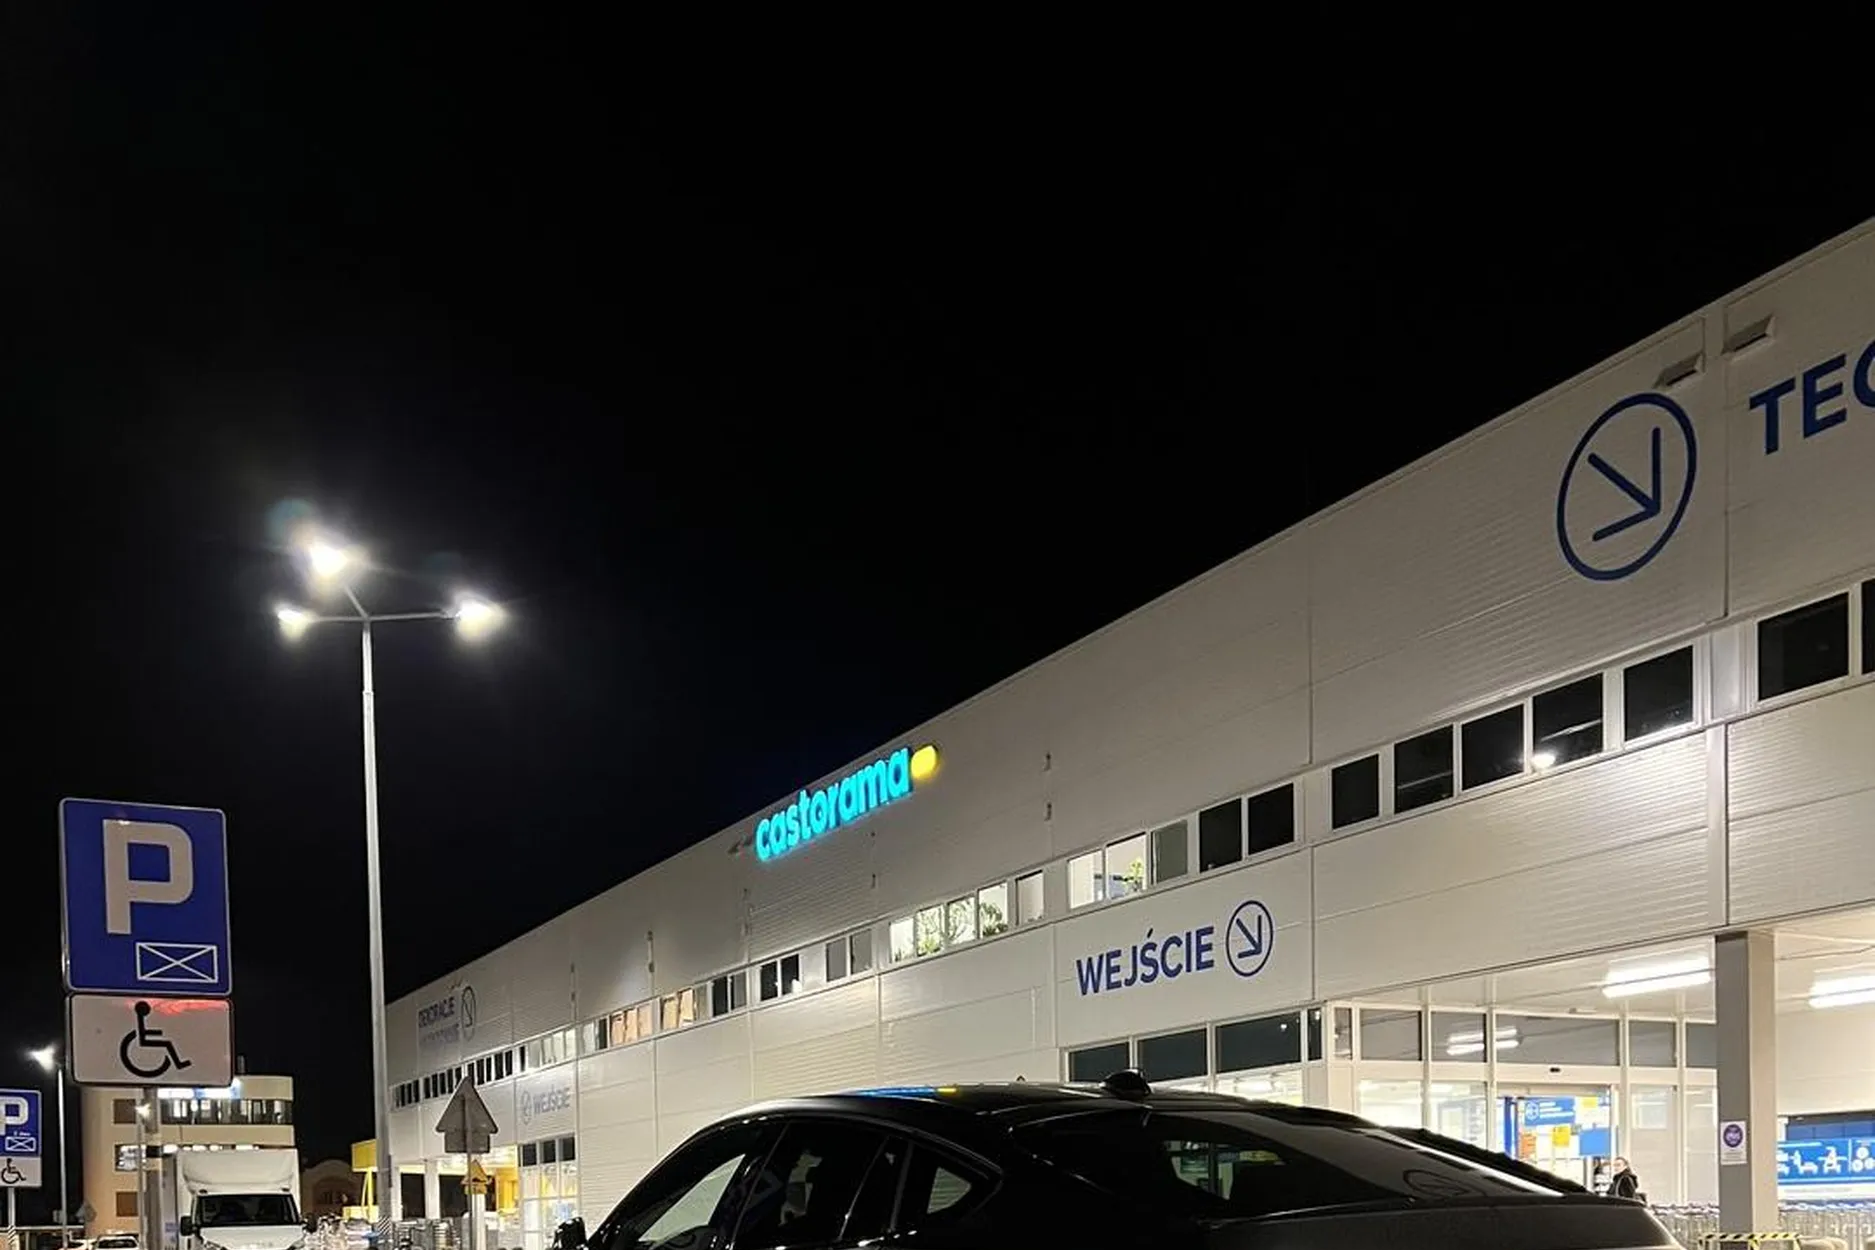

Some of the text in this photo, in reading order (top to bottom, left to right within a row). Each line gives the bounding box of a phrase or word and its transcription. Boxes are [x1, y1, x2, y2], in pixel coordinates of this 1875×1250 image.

[756, 748, 910, 861] castorama
[103, 820, 193, 934] P
[1076, 917, 1215, 996] WEJŚCIE
